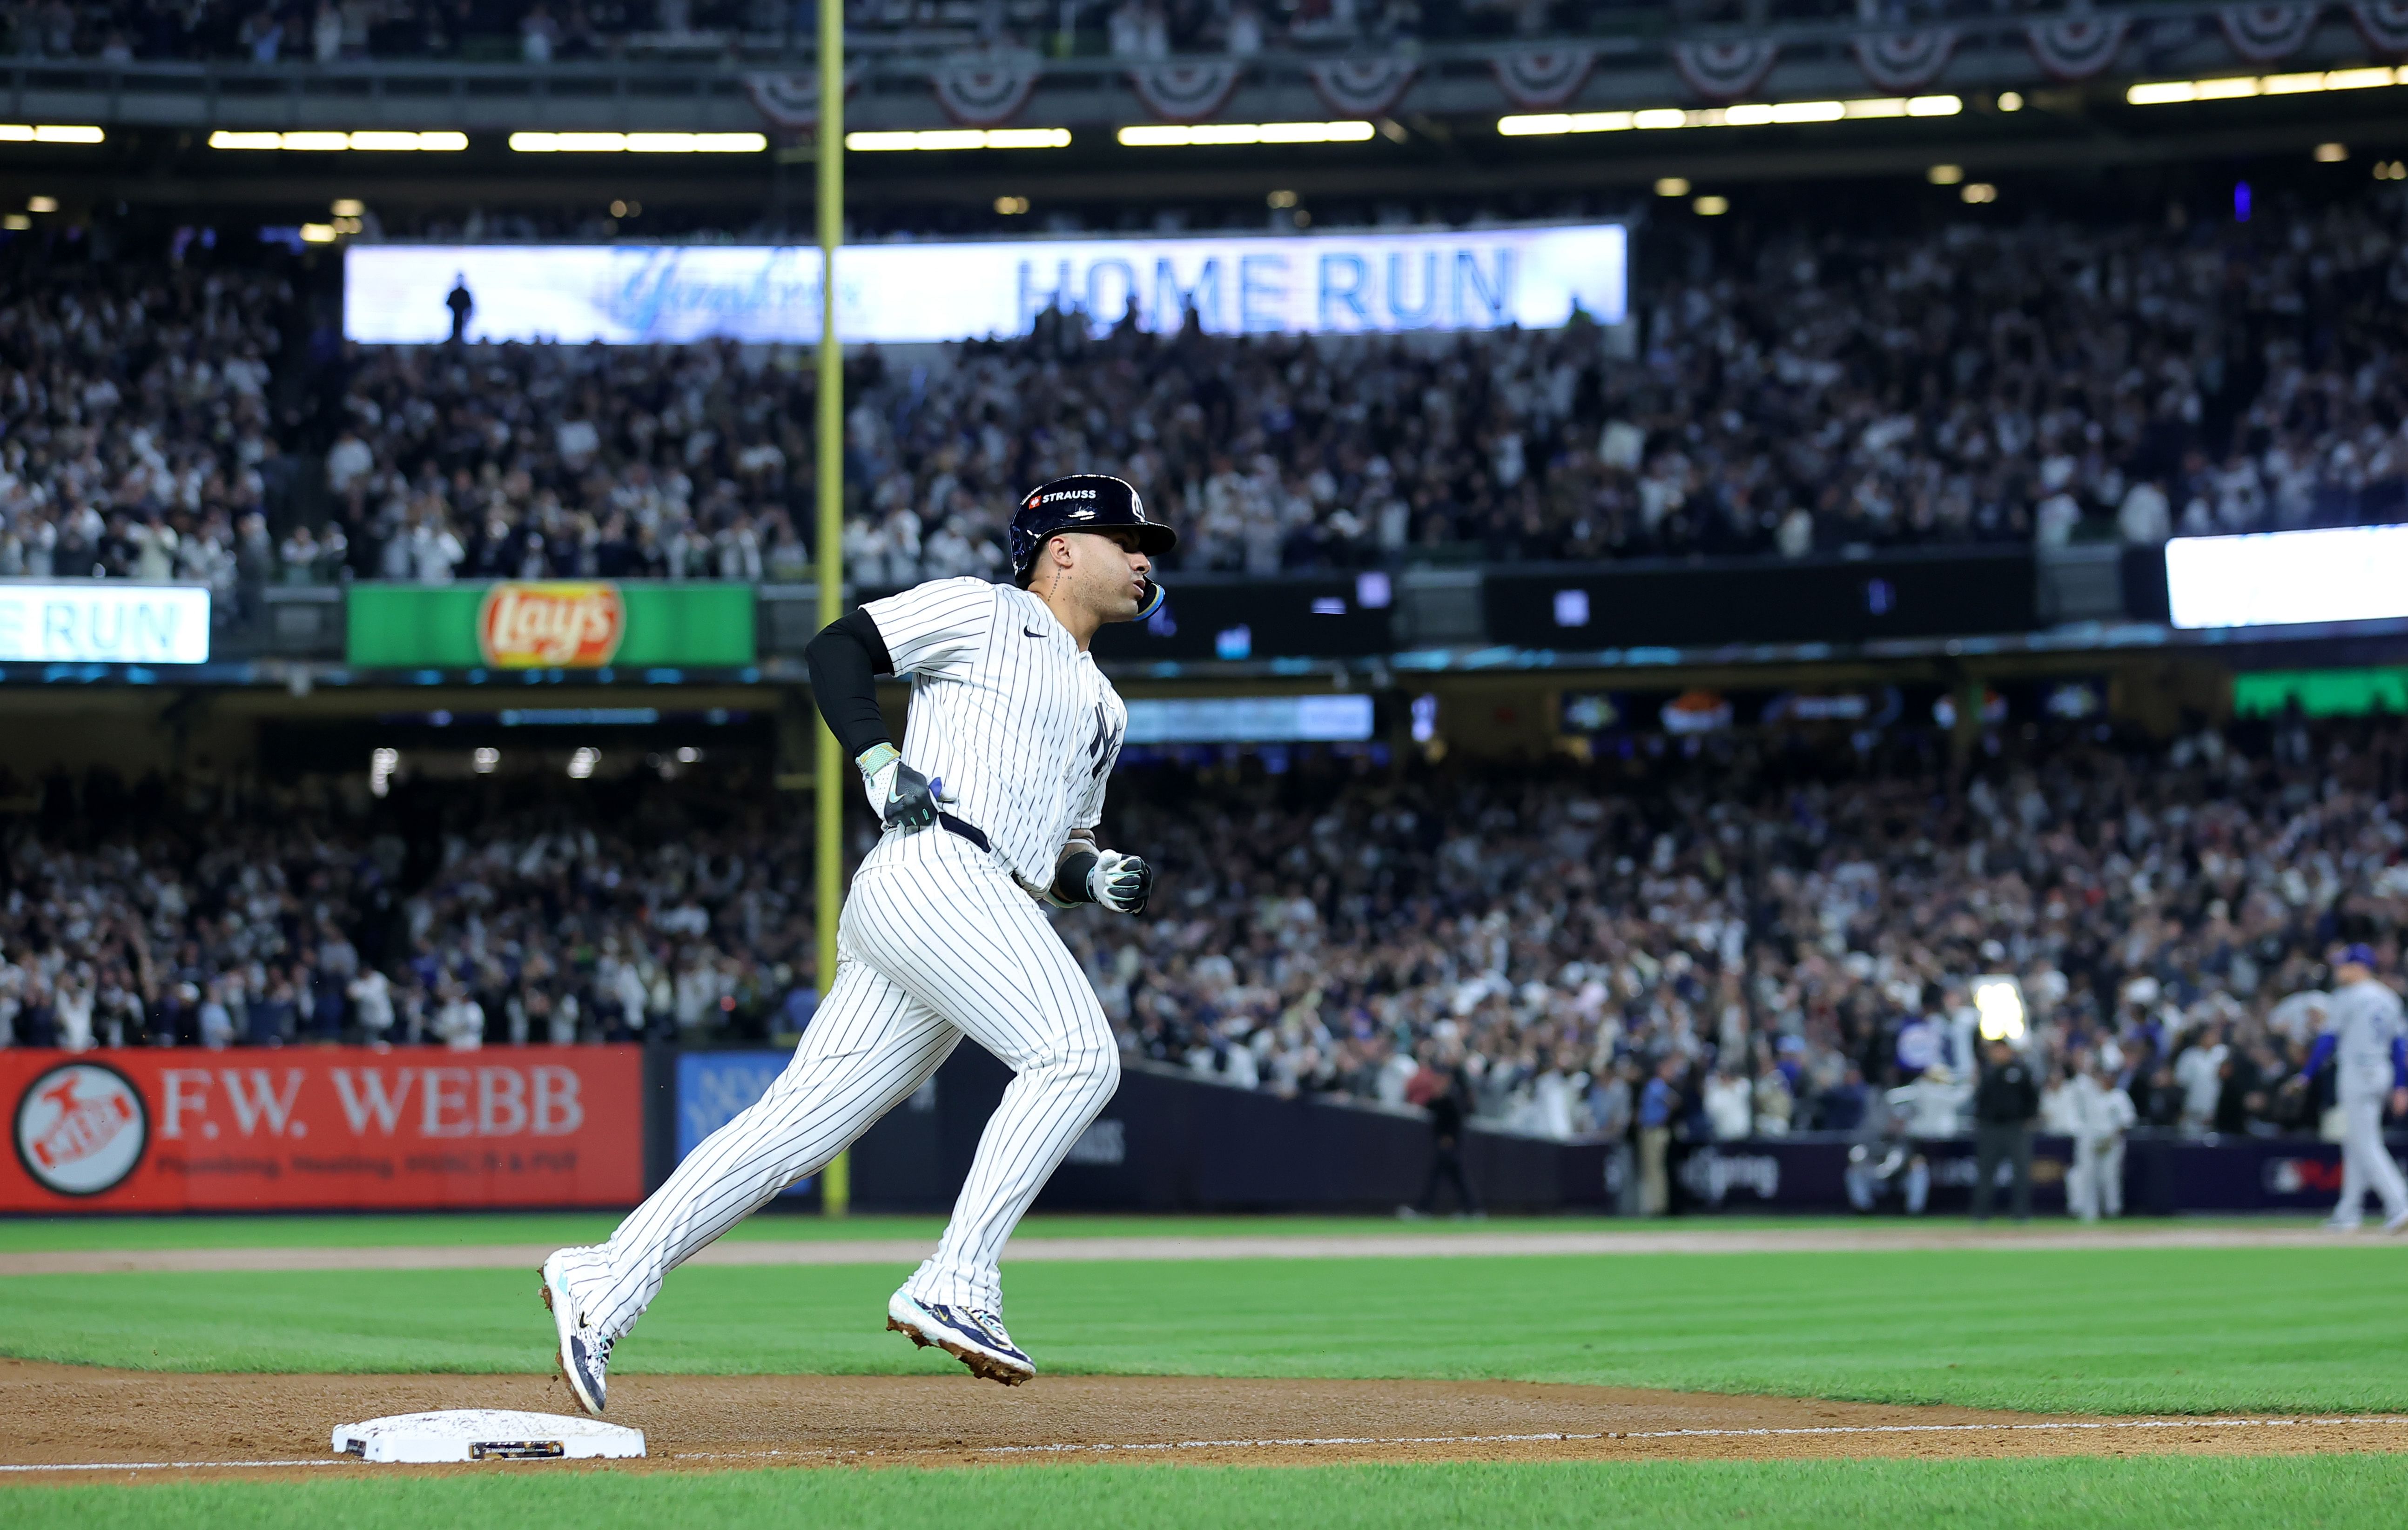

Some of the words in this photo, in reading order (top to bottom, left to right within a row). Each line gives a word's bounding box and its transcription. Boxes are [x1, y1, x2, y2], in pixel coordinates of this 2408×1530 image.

[1019, 255, 1288, 332] HOME
[1319, 248, 1513, 328] RUN
[1042, 490, 1096, 503] STRAUSS
[43, 602, 175, 650] RUN
[159, 1067, 308, 1139] F.W.
[329, 1065, 584, 1137] WEBB
